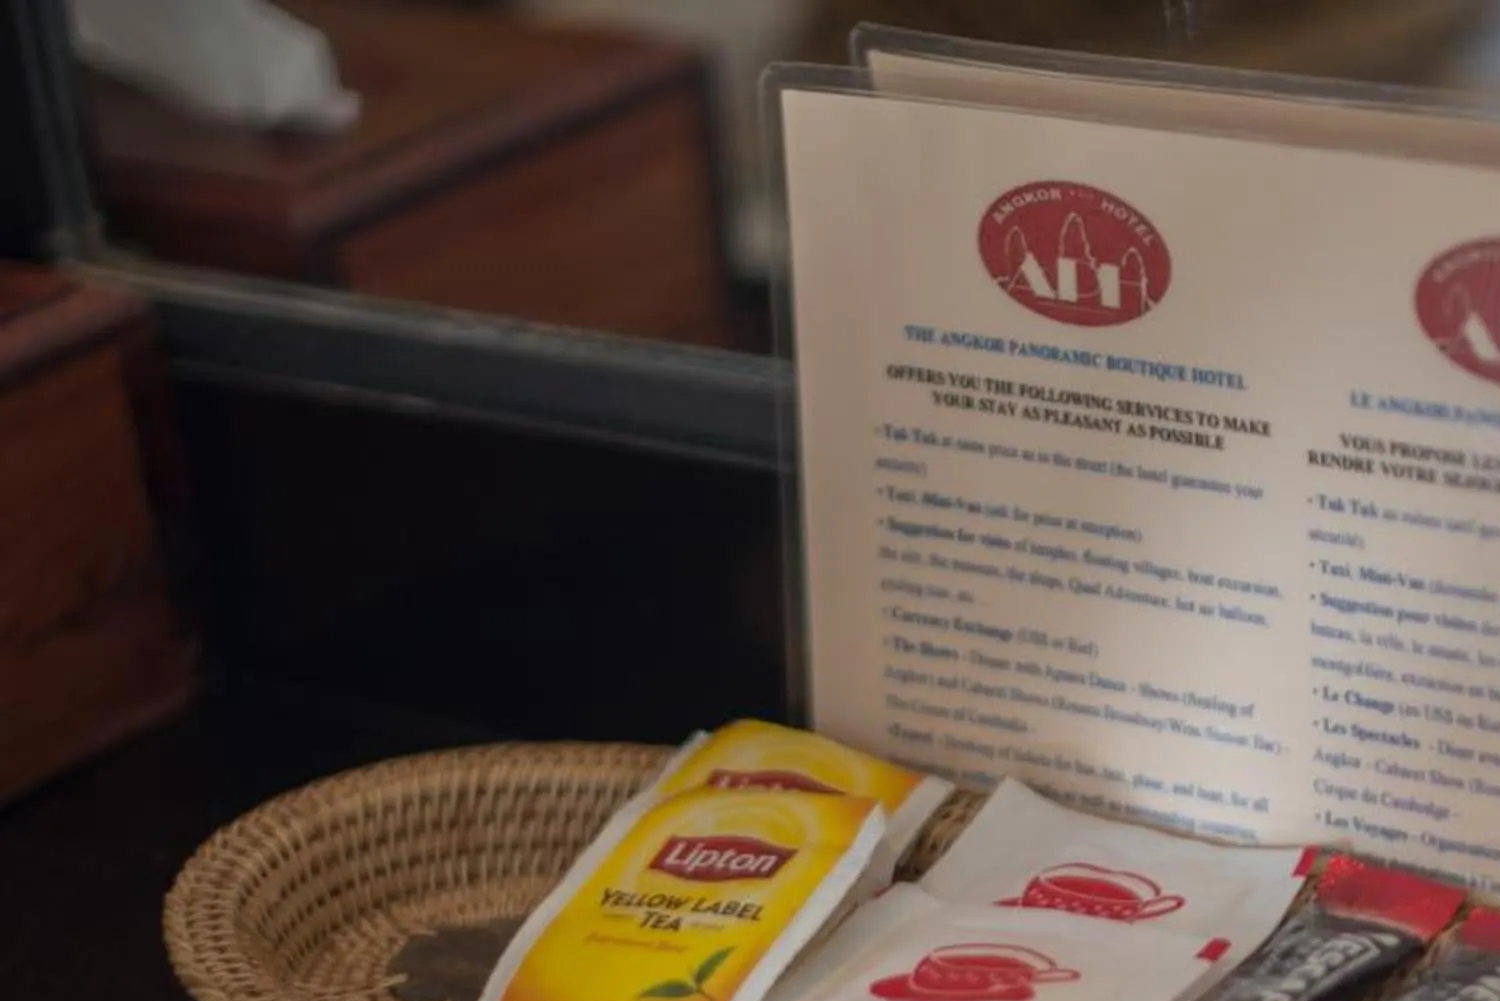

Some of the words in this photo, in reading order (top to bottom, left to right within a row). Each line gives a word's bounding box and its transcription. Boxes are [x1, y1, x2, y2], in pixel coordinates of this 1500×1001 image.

[992, 187, 1063, 225] ANGKOR
[1101, 198, 1155, 247] HOTEL
[904, 325, 934, 343] THE
[940, 330, 1005, 353] ANGKOR
[1009, 340, 1100, 367] PANORAMIC
[1106, 354, 1186, 381] BOUTIQUE
[1192, 366, 1247, 388] HOTEL
[886, 363, 945, 386] OFFERS
[949, 372, 976, 391] YOU
[985, 377, 1013, 396] THE
[1019, 382, 1112, 411] FOLLOWING
[1115, 397, 1192, 423] SERVICES
[1197, 409, 1219, 427] TO
[1222, 413, 1271, 435] MAKE
[1350, 391, 1369, 409] LE
[884, 424, 907, 441] Tuk
[913, 428, 937, 445] Tuk
[932, 390, 974, 411] YOUR
[978, 397, 1016, 418] STAY
[1022, 404, 1040, 421] AS
[1044, 407, 1120, 434] PLEASANT
[1126, 420, 1146, 438] AS
[1149, 423, 1225, 450] POSSIBLE
[1307, 449, 1374, 475] RENDRE
[1380, 461, 1436, 484] VOTRE
[1340, 433, 1385, 454] VOUS
[1390, 440, 1466, 467] PROPOSE
[1318, 494, 1343, 512] Tuk
[1349, 499, 1377, 518] Tuk
[1322, 685, 1339, 703] Le
[1344, 689, 1394, 717] Change
[1322, 717, 1346, 736] Les
[664, 840, 778, 873] Lipton
[600, 887, 689, 911] YELLOW
[691, 897, 765, 922] LABEL
[639, 911, 684, 932] TEA
